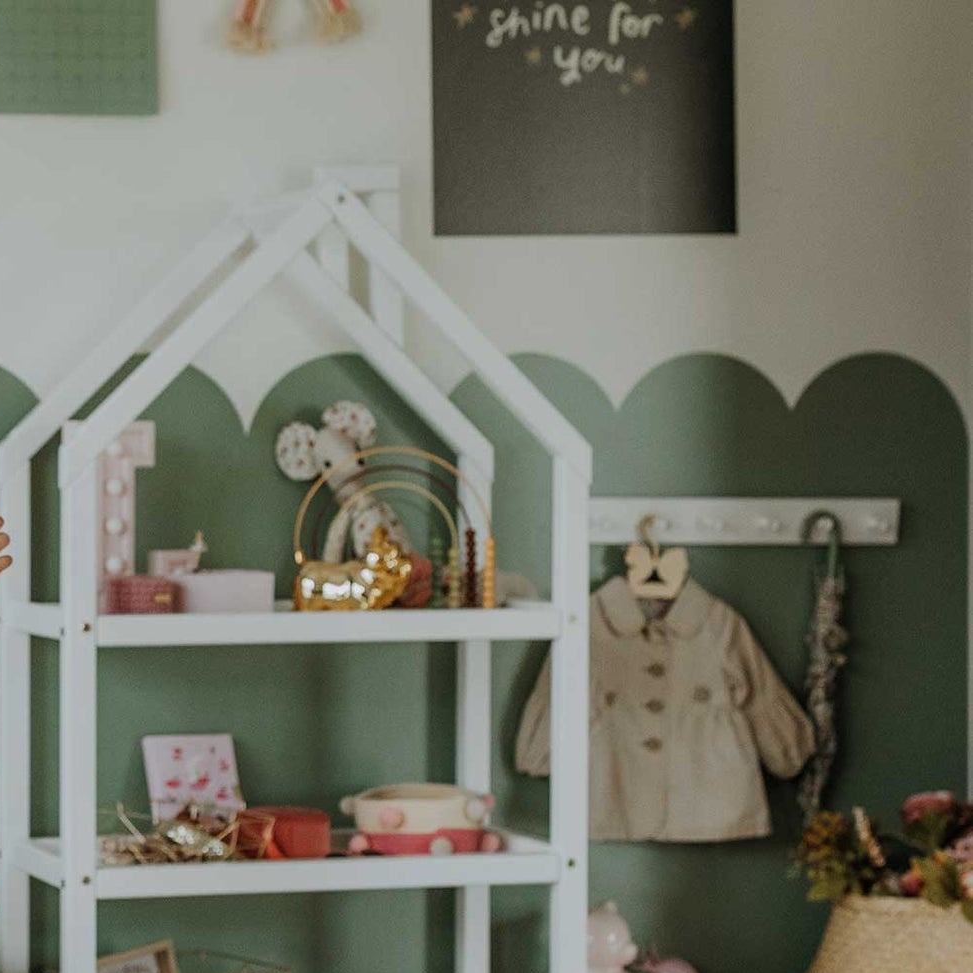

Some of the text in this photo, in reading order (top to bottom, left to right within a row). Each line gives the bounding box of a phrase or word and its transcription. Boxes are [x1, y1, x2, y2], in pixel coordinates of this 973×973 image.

[486, 1, 664, 47] shine for
[553, 45, 625, 86] you
